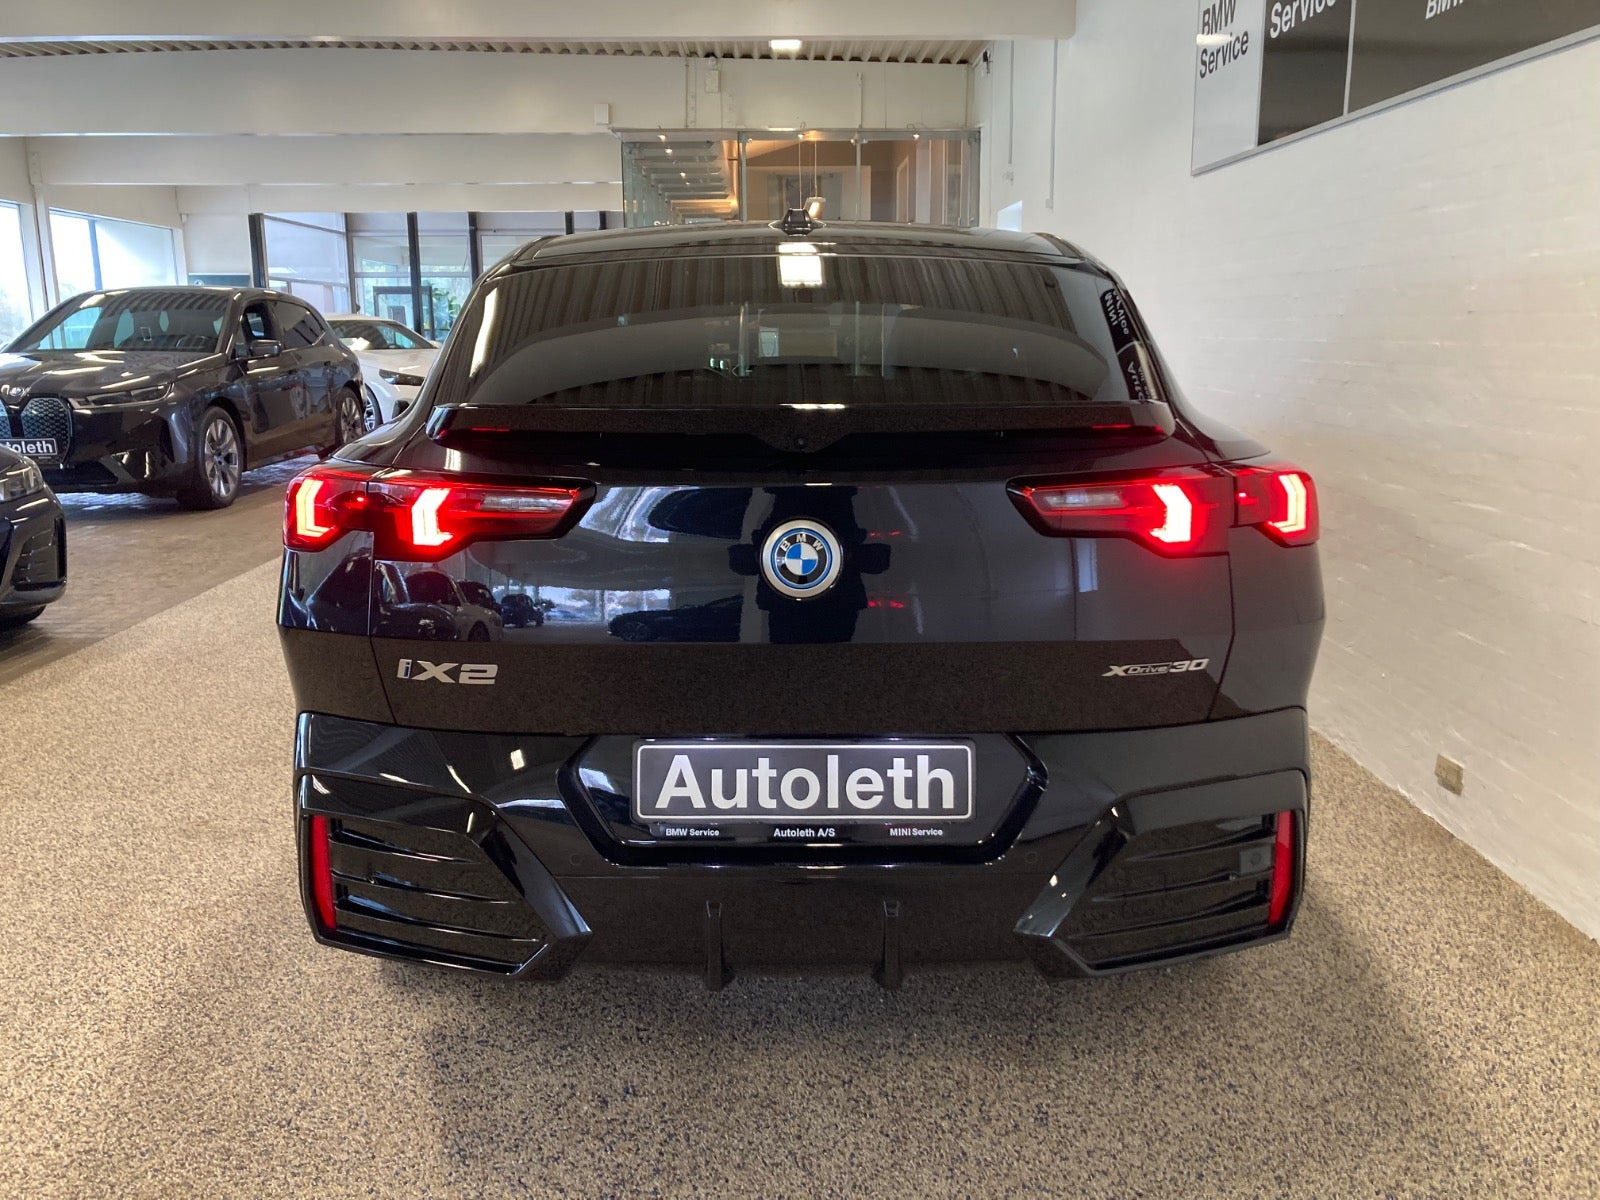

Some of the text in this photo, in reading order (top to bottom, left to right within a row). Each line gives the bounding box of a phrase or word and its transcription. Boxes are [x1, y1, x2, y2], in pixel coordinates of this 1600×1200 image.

[1201, 0, 1236, 36] BMW
[1269, 0, 1336, 39] Servi
[1199, 30, 1249, 79] Service
[780, 533, 823, 551] BMW
[396, 658, 498, 685] iX2
[654, 754, 955, 810] Autoleth
[665, 828, 719, 837] BMW Service
[773, 828, 836, 838] Autoleth A/S
[889, 828, 943, 837] MINI Service
